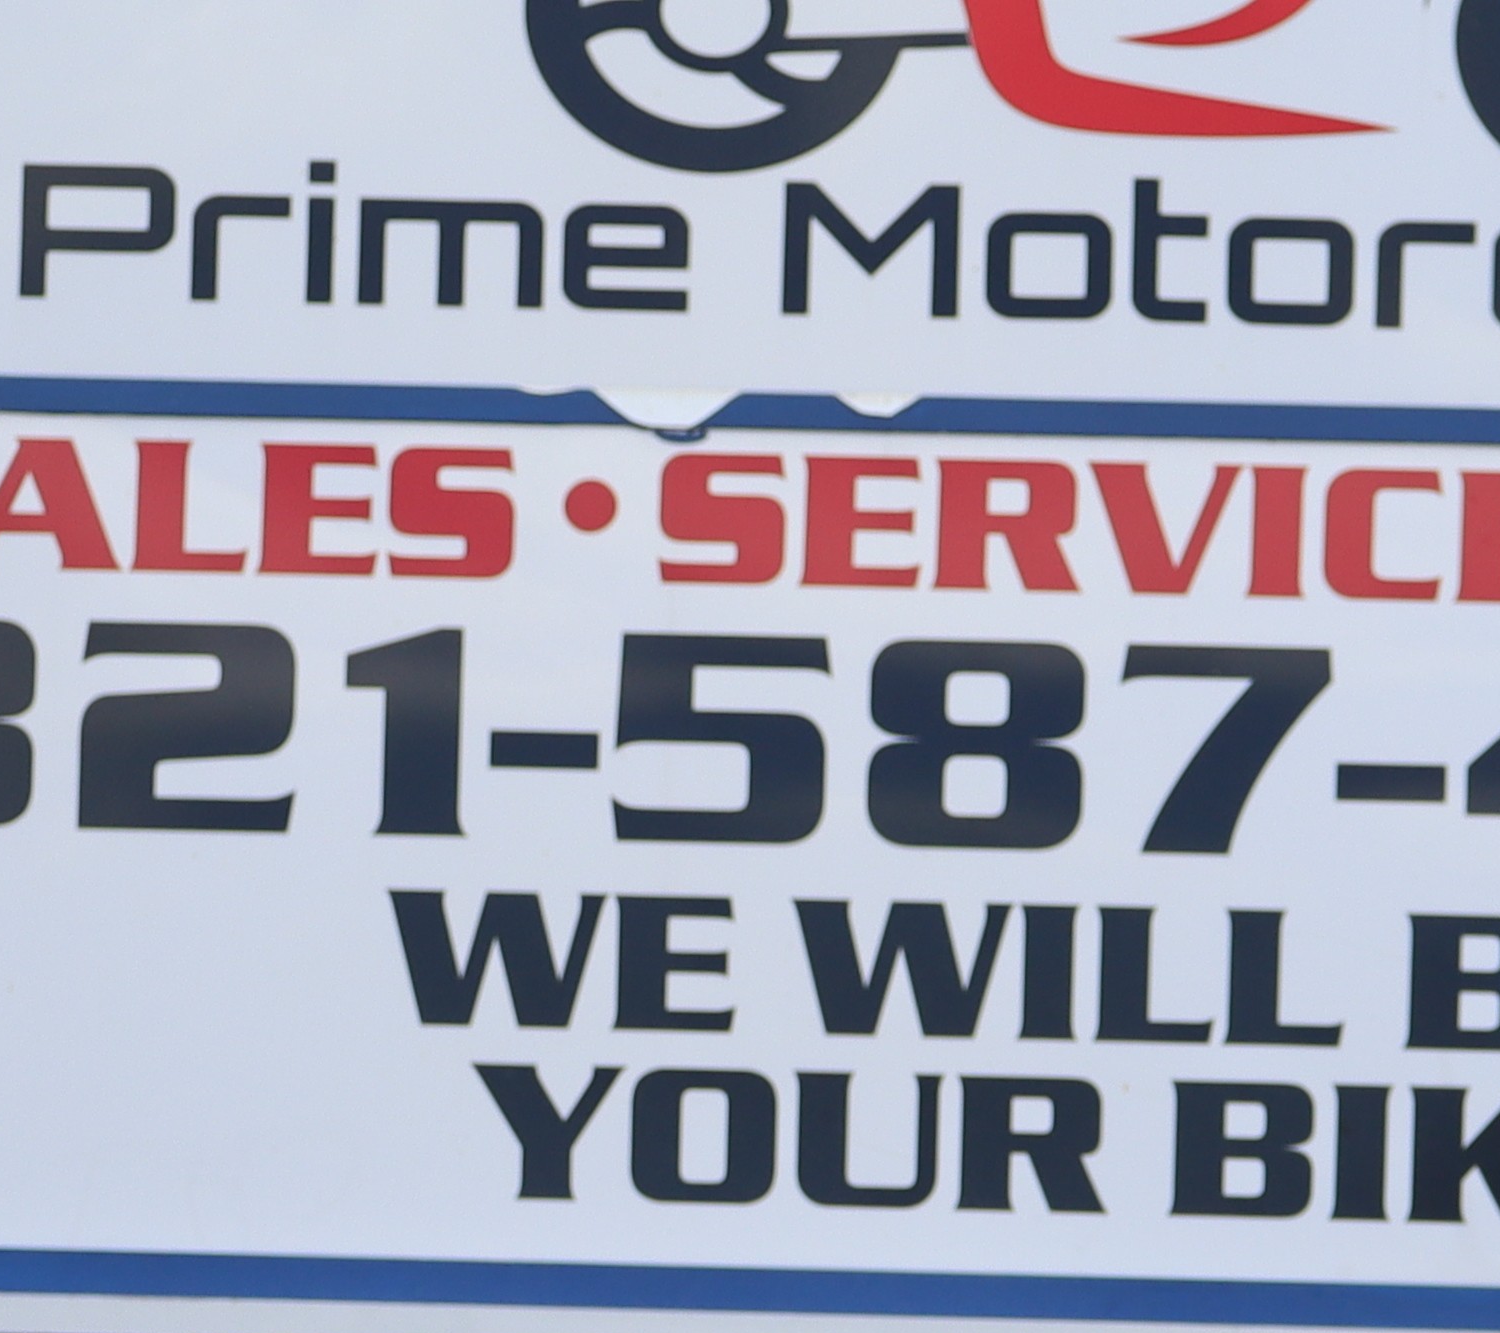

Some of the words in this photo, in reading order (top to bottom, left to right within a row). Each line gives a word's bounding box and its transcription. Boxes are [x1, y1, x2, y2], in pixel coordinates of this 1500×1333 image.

[19, 164, 690, 312] Prime
[388, 890, 735, 1032] WE
[794, 899, 1343, 1047] WILL
[473, 1063, 1106, 1214] YOUR
